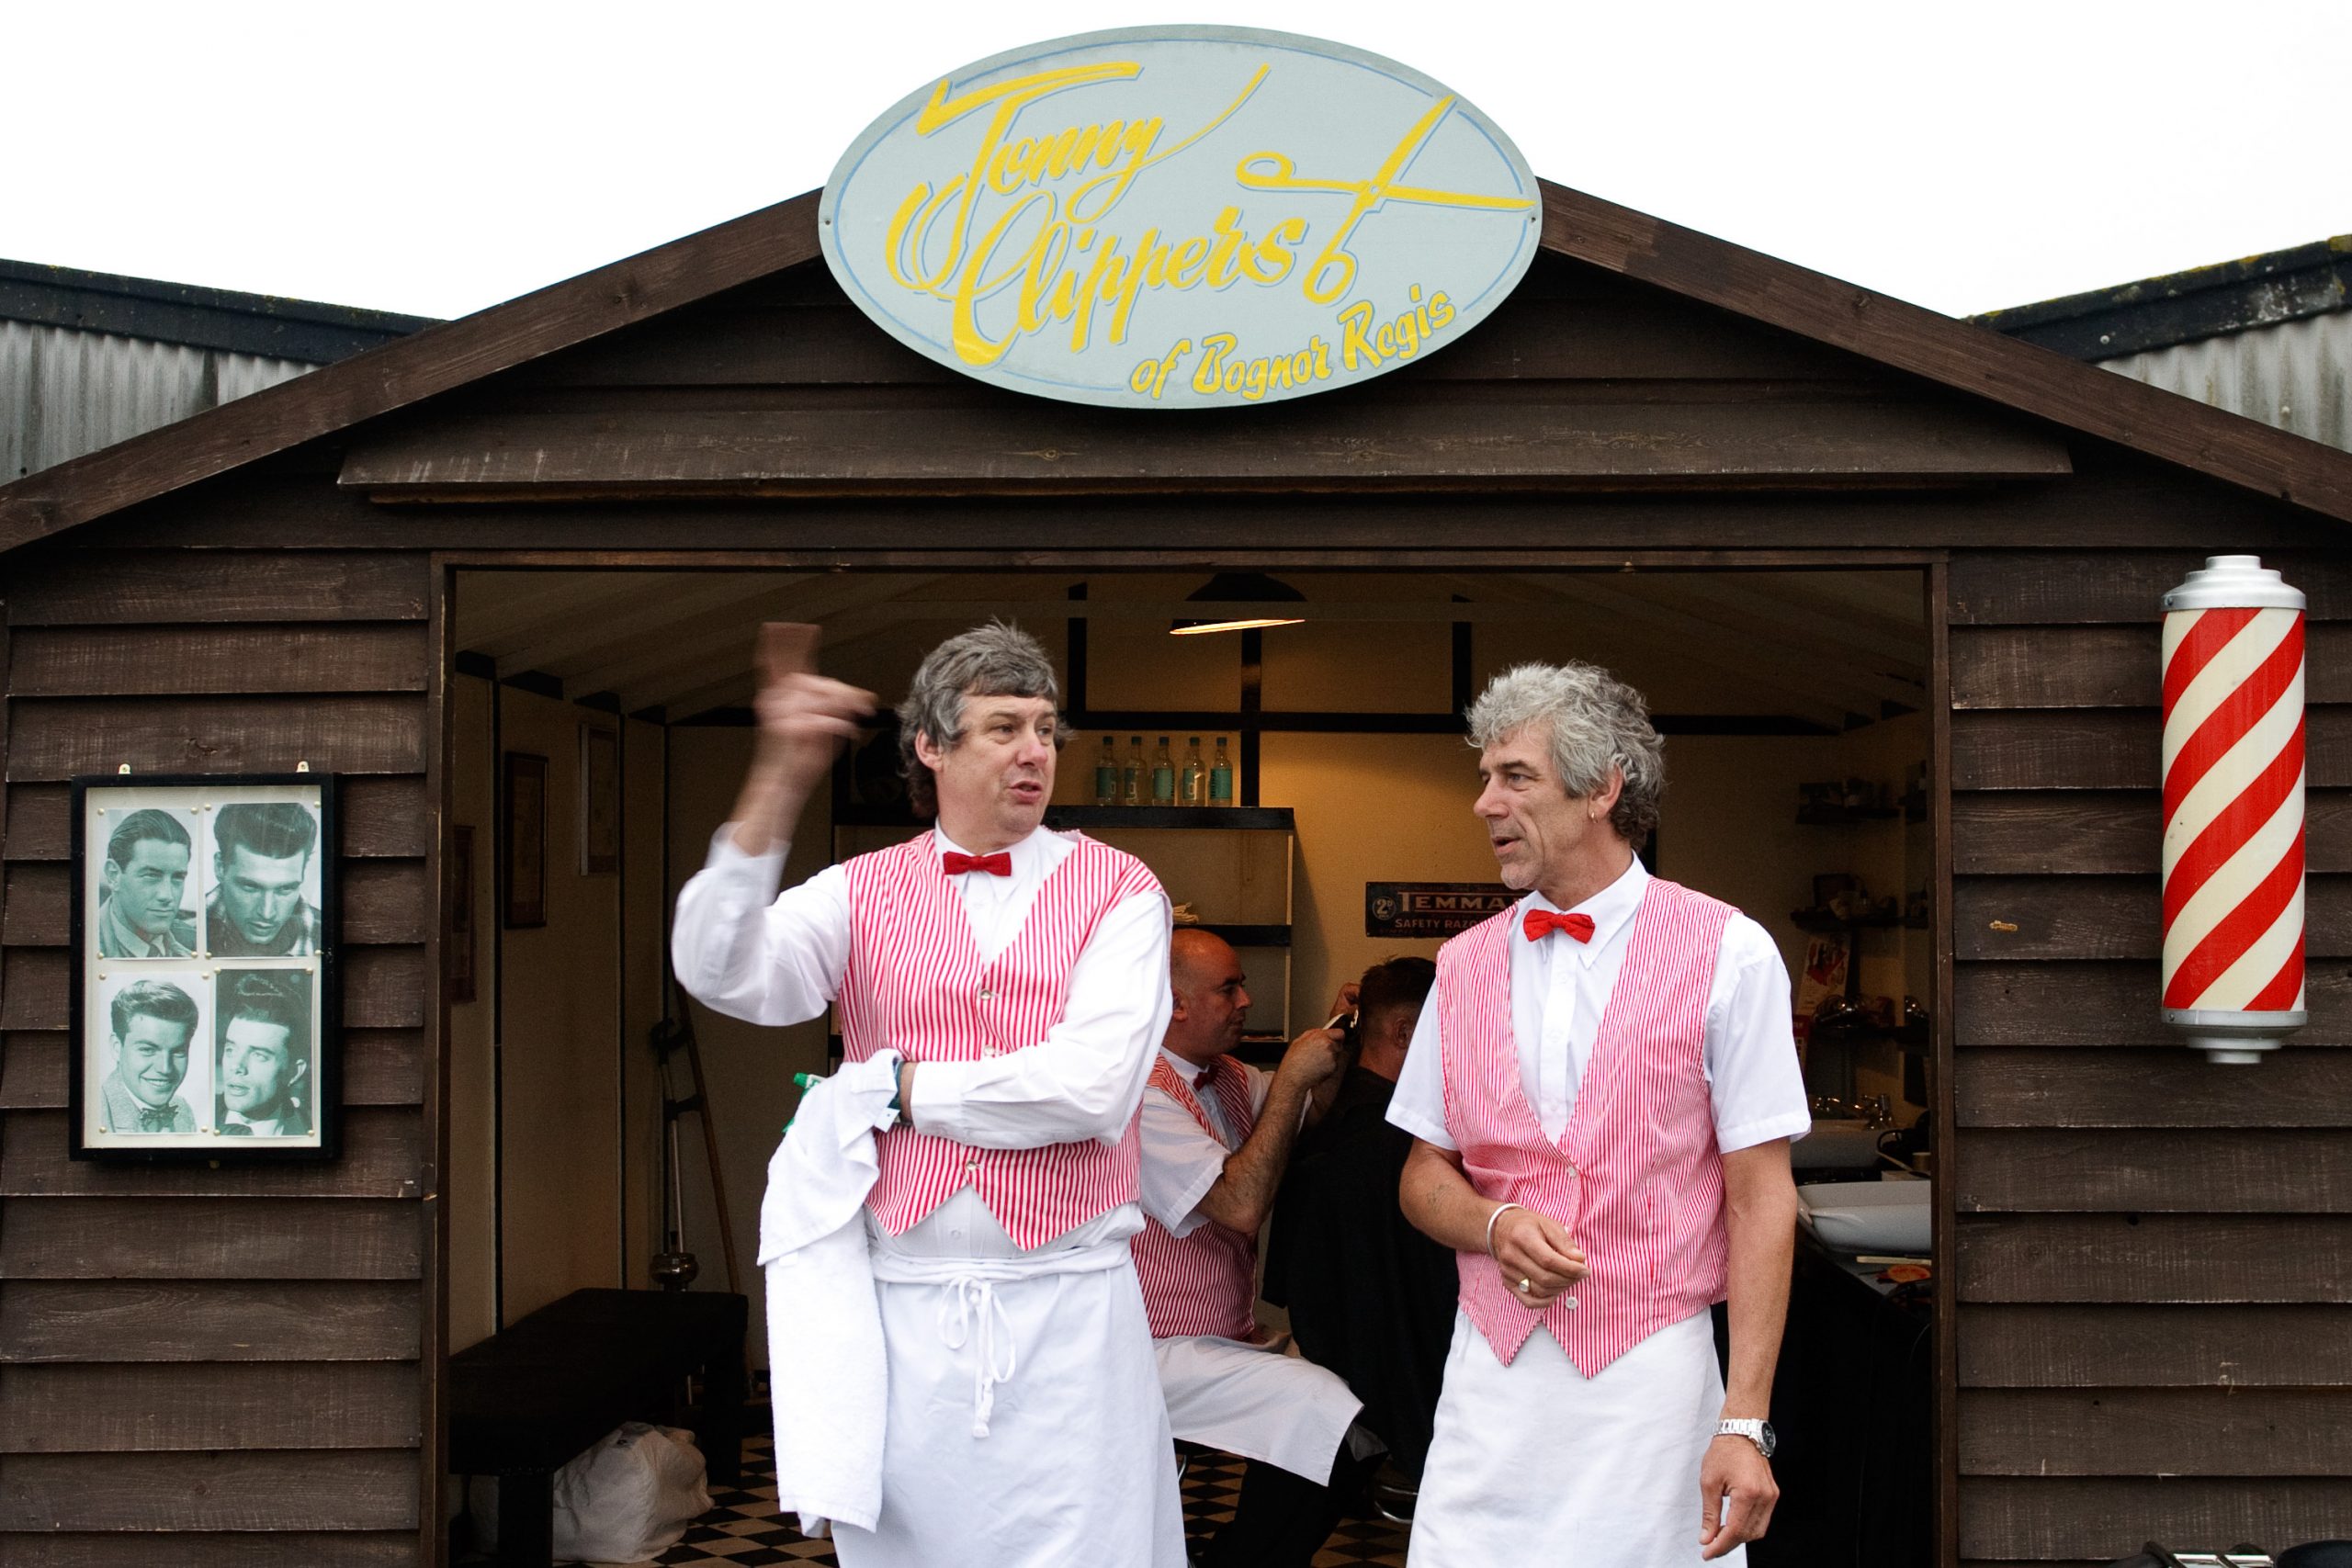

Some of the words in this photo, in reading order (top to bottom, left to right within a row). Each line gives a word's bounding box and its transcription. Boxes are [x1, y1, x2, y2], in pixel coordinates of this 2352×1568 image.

[912, 173, 1306, 367] Clippers
[1130, 338, 1193, 400] of
[1193, 333, 1331, 401] Bognor
[1336, 283, 1457, 370] Regis
[1395, 919, 1441, 929] SAFETY
[1443, 919, 1482, 929] RAZO
[1397, 891, 1518, 912] TEMMA
